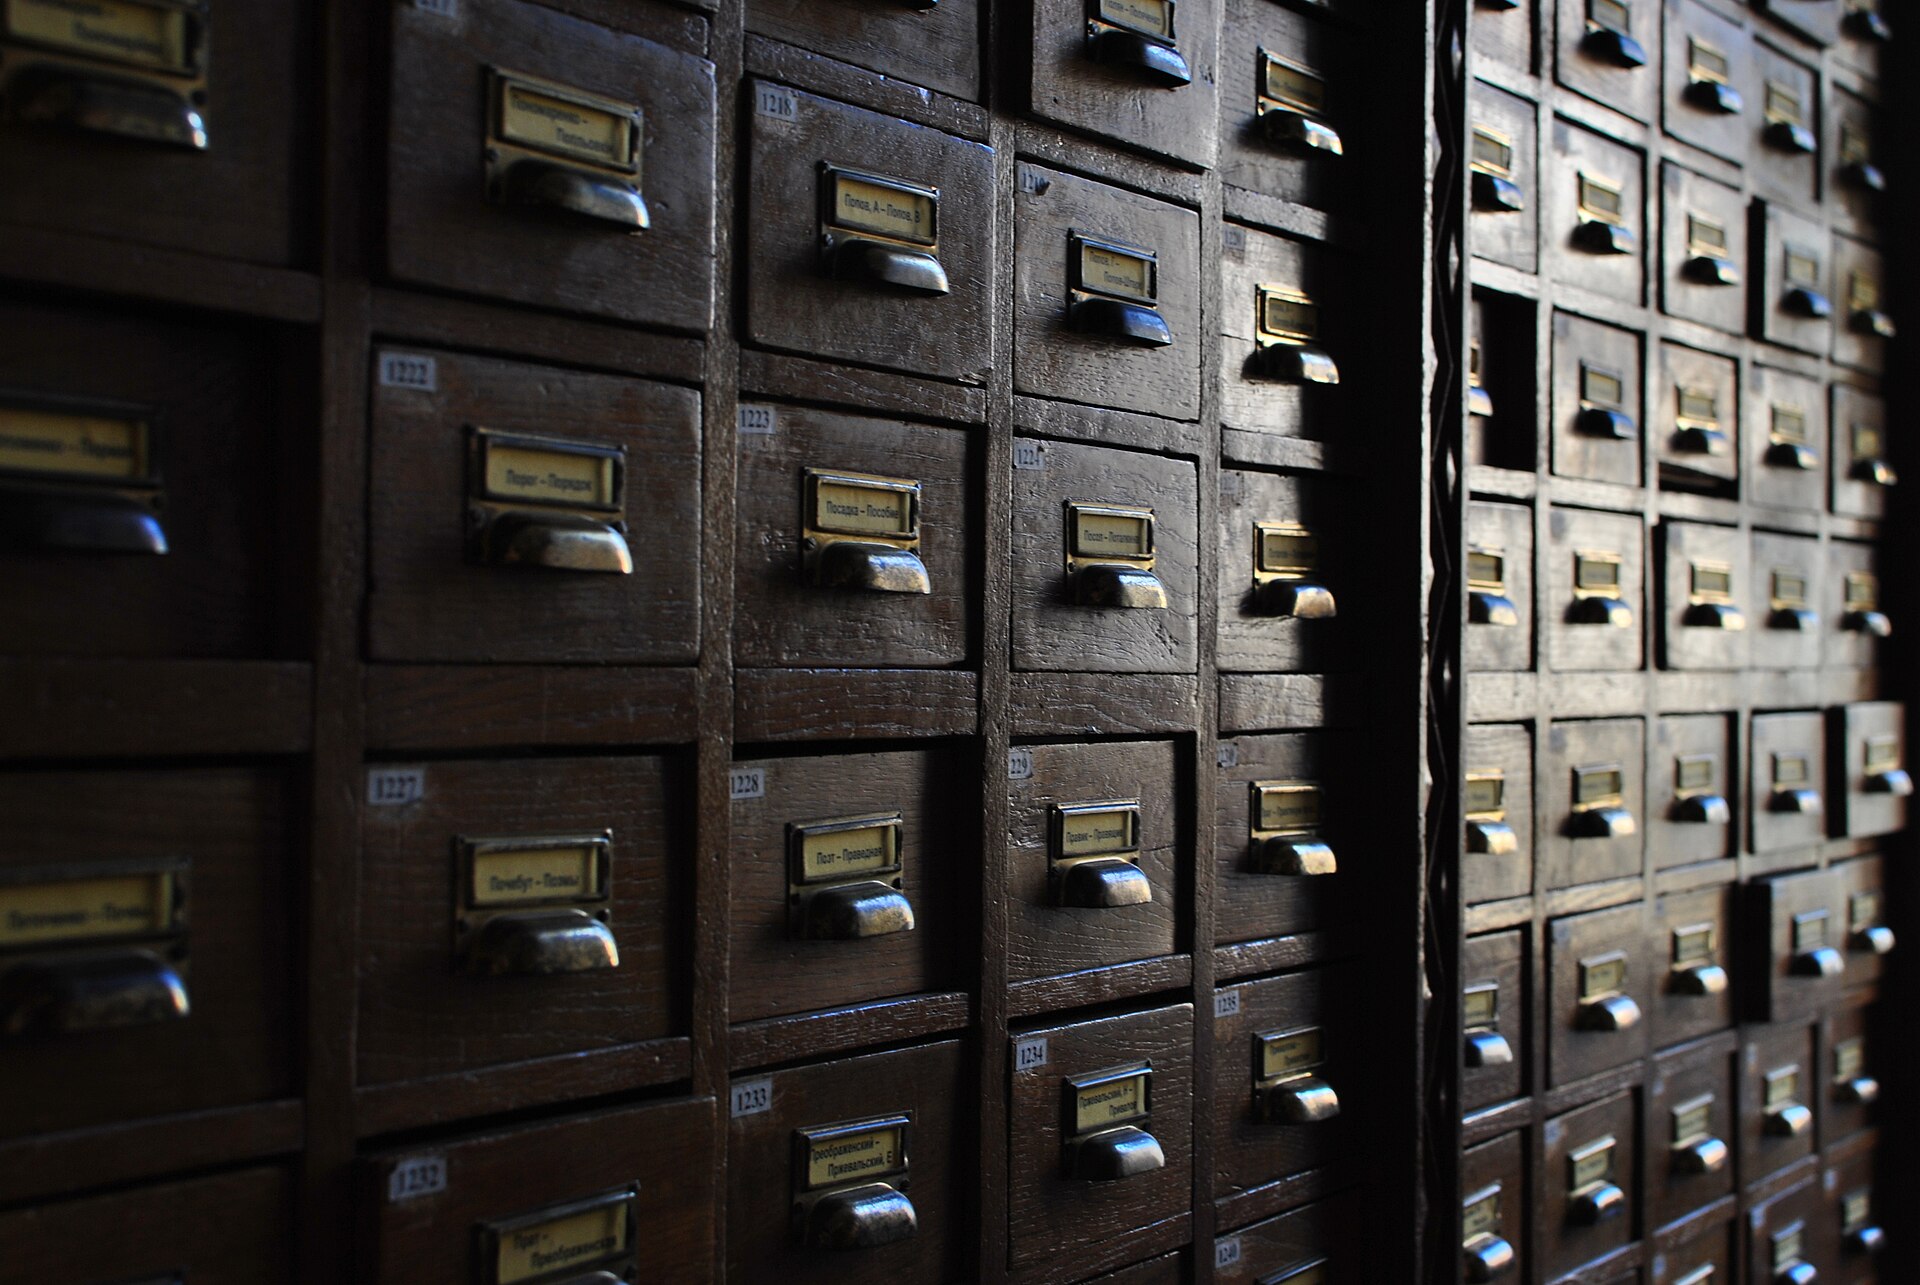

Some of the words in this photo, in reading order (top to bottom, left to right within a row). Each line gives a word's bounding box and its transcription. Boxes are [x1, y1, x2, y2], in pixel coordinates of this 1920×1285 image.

[761, 92, 793, 116] 1218
[387, 359, 428, 385] 1222
[740, 409, 770, 429] 1223
[826, 500, 859, 517] Посадка
[867, 503, 900, 520] Пособие
[376, 775, 418, 801] 1227
[731, 774, 759, 794] 1228
[816, 852, 836, 866] Поэт
[1020, 1045, 1044, 1065] 1234
[737, 1088, 767, 1112] 1233
[398, 1164, 440, 1194] 1232
